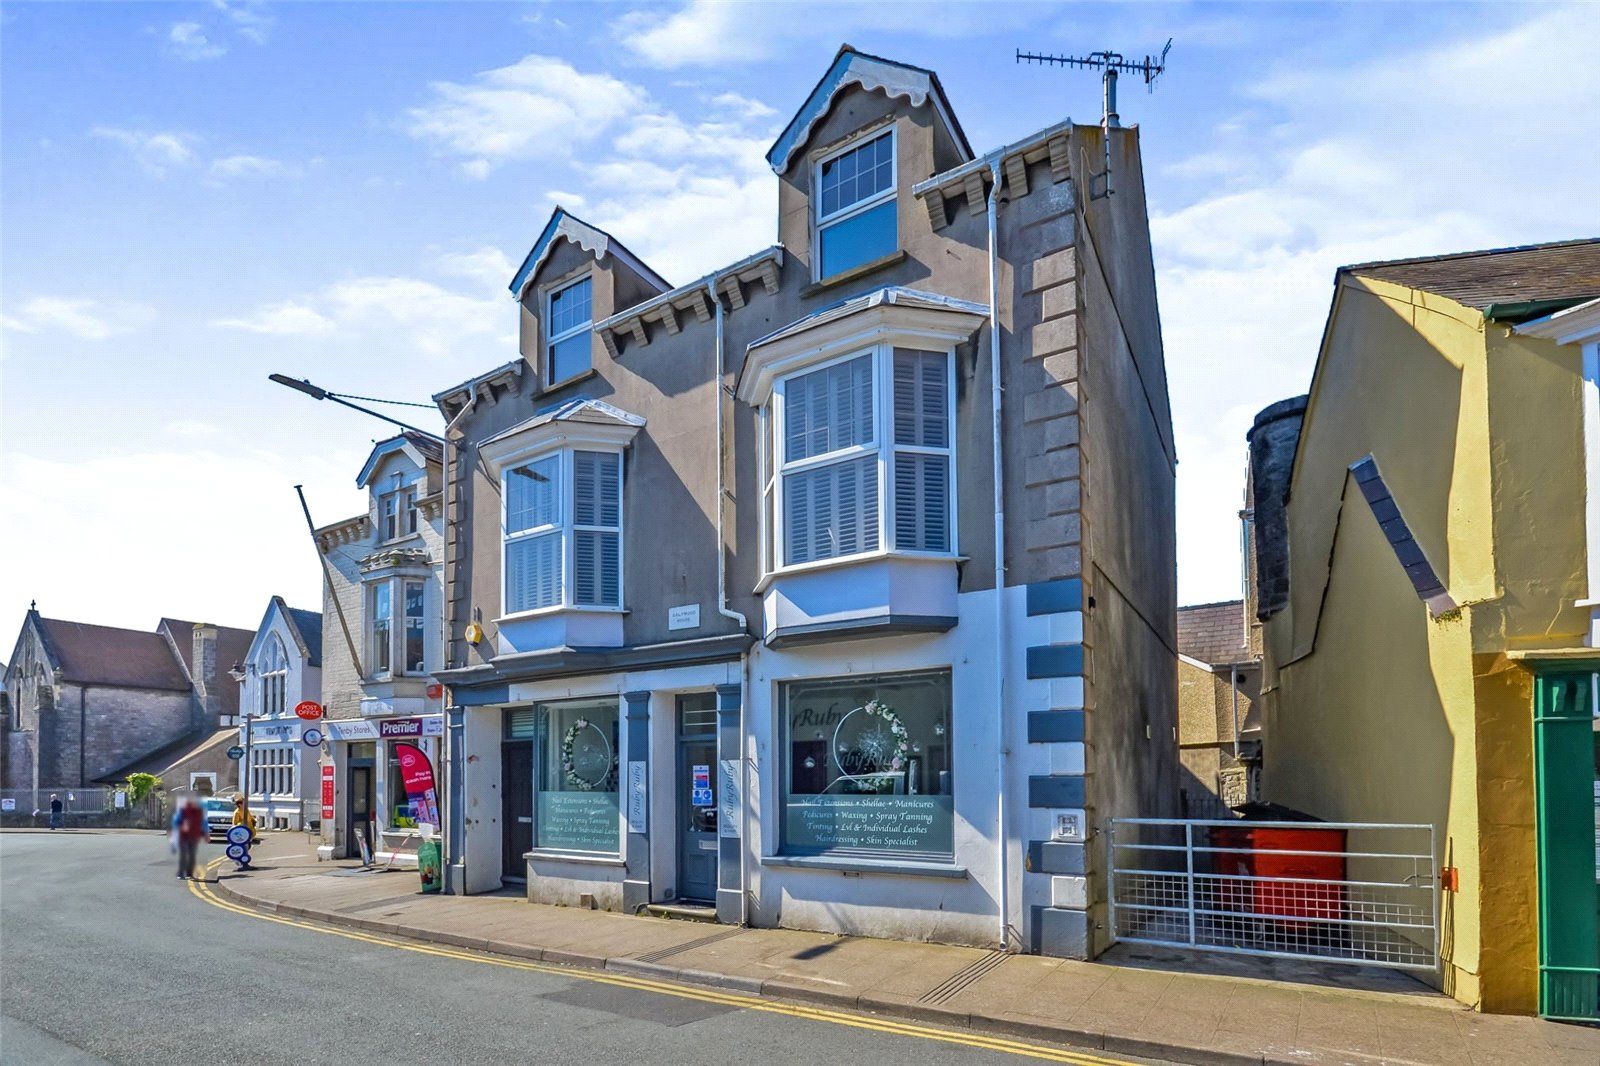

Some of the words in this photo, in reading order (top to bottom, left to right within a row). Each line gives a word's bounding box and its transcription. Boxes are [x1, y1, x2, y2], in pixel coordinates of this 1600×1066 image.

[382, 722, 420, 734] Premier
[631, 765, 644, 816] RubyRuby
[724, 763, 738, 818] RubyRuby
[895, 799, 934, 809] Manicures
[802, 810, 833, 819] Pedicures
[841, 811, 868, 822] Waxing
[875, 812, 897, 823] Spray
[899, 812, 933, 824] Tanning
[806, 821, 833, 833] Tinting
[853, 824, 862, 832] &
[863, 822, 901, 833] Individual
[902, 825, 928, 834] Lashes
[815, 834, 859, 846] Hairdressing
[866, 836, 882, 845] Skin
[884, 836, 918, 848] Specialist
